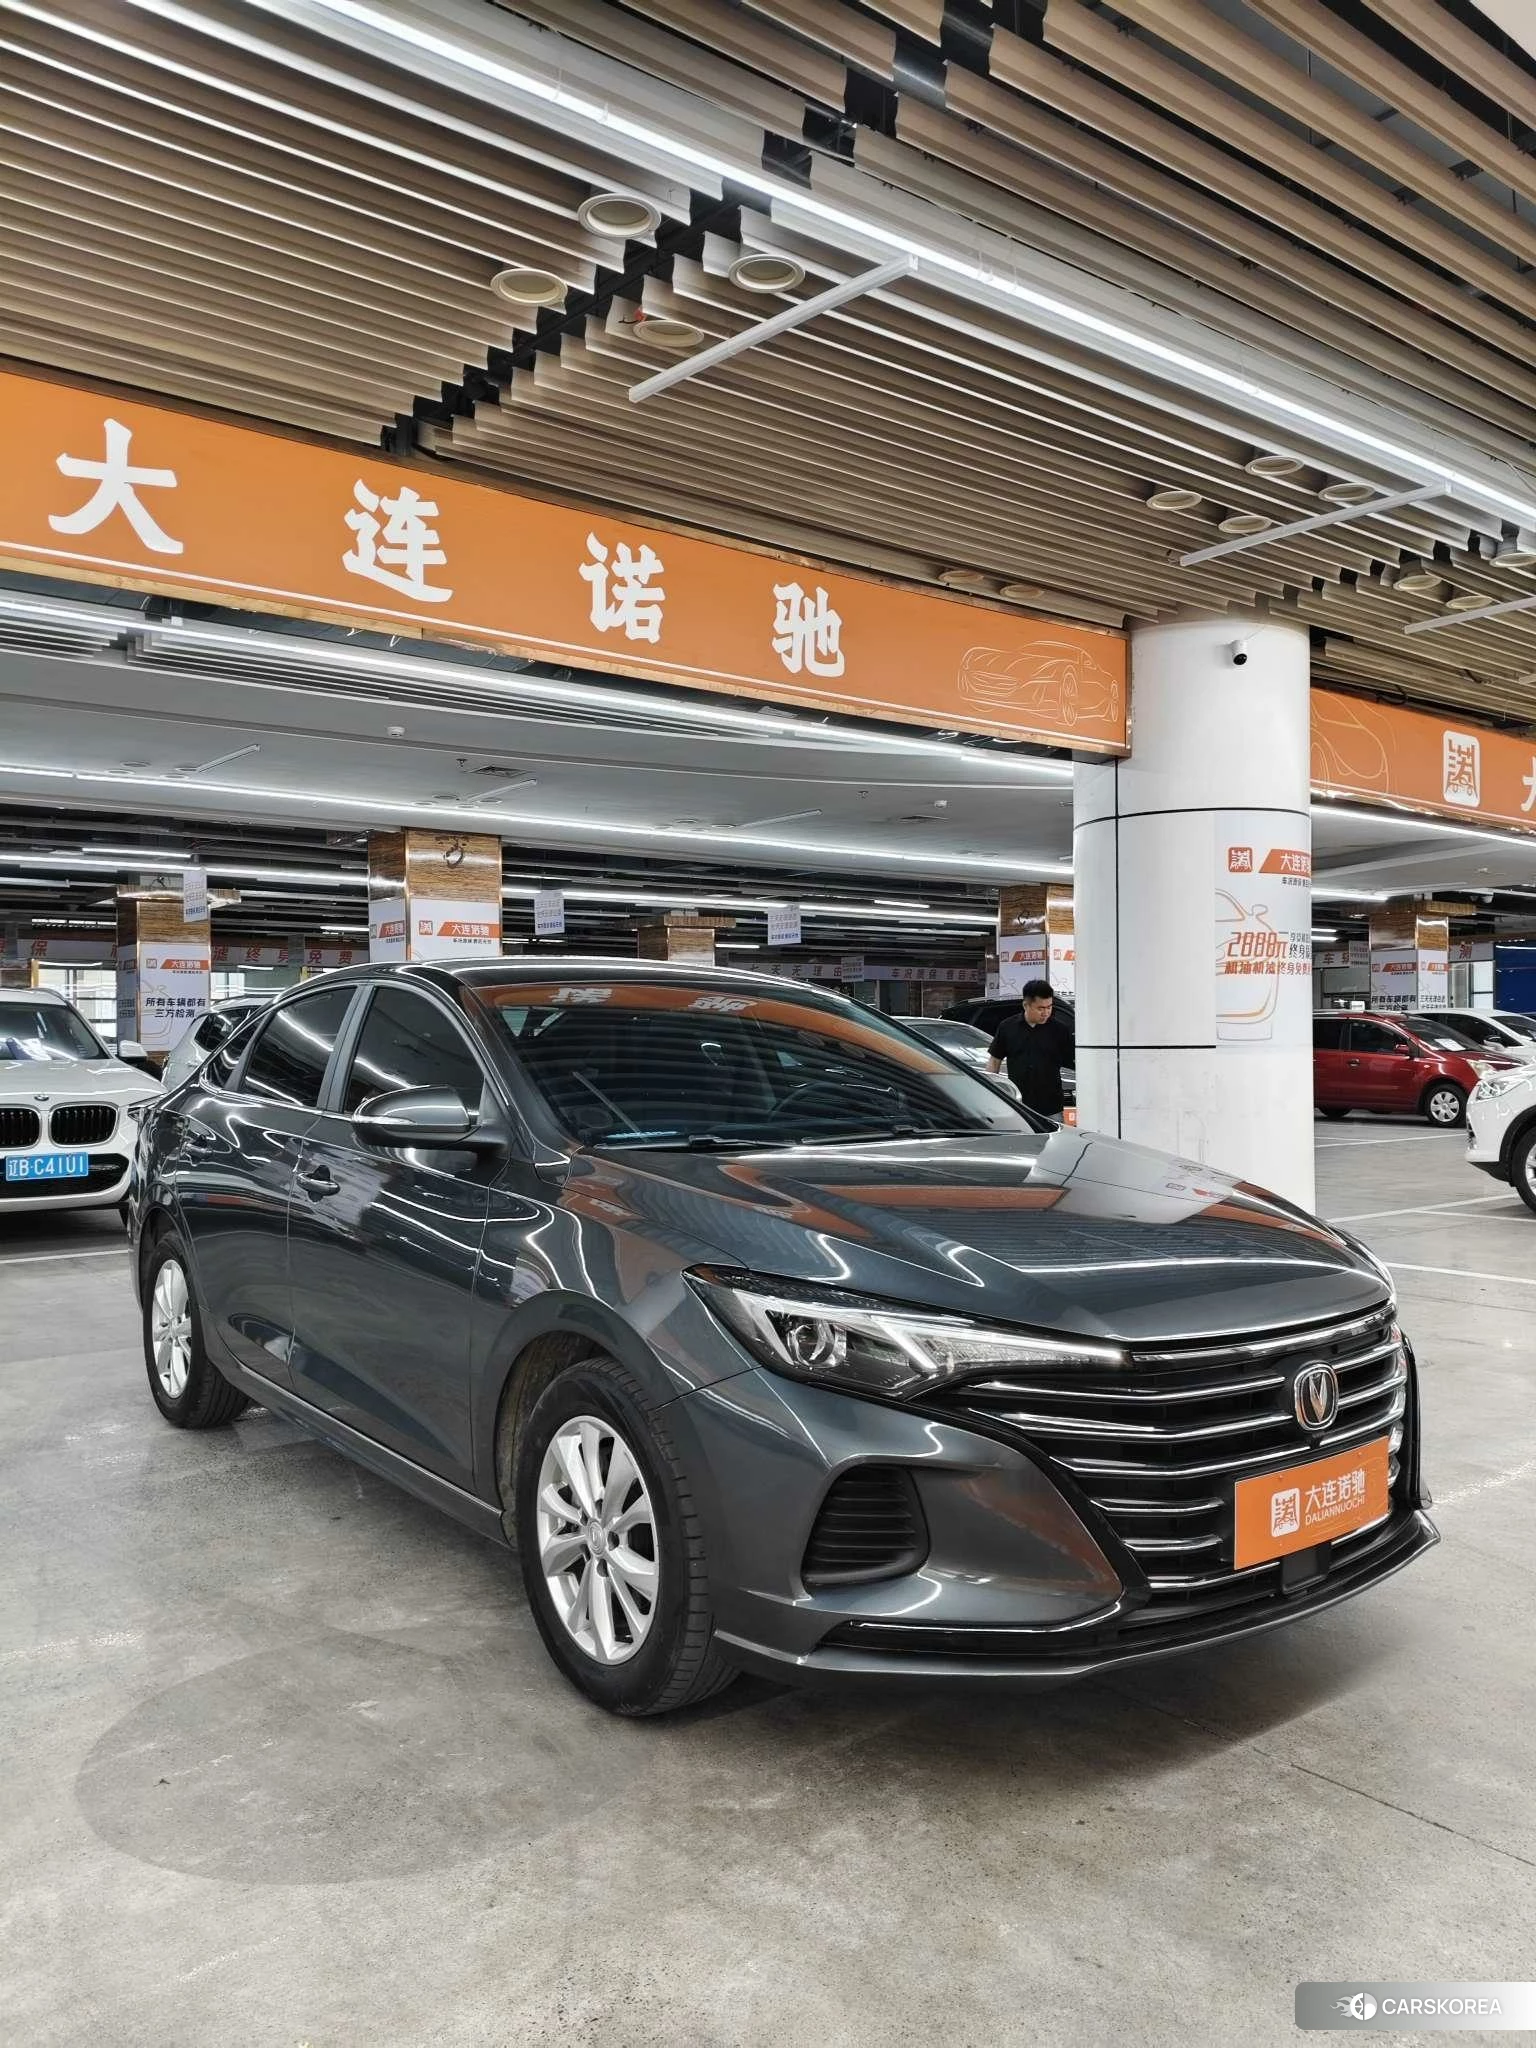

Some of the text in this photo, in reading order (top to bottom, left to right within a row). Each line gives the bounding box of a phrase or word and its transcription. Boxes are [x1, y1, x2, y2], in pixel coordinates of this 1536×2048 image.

[48, 418, 846, 678] 大连诺驰
[1305, 1468, 1366, 1514] 大连诺驰
